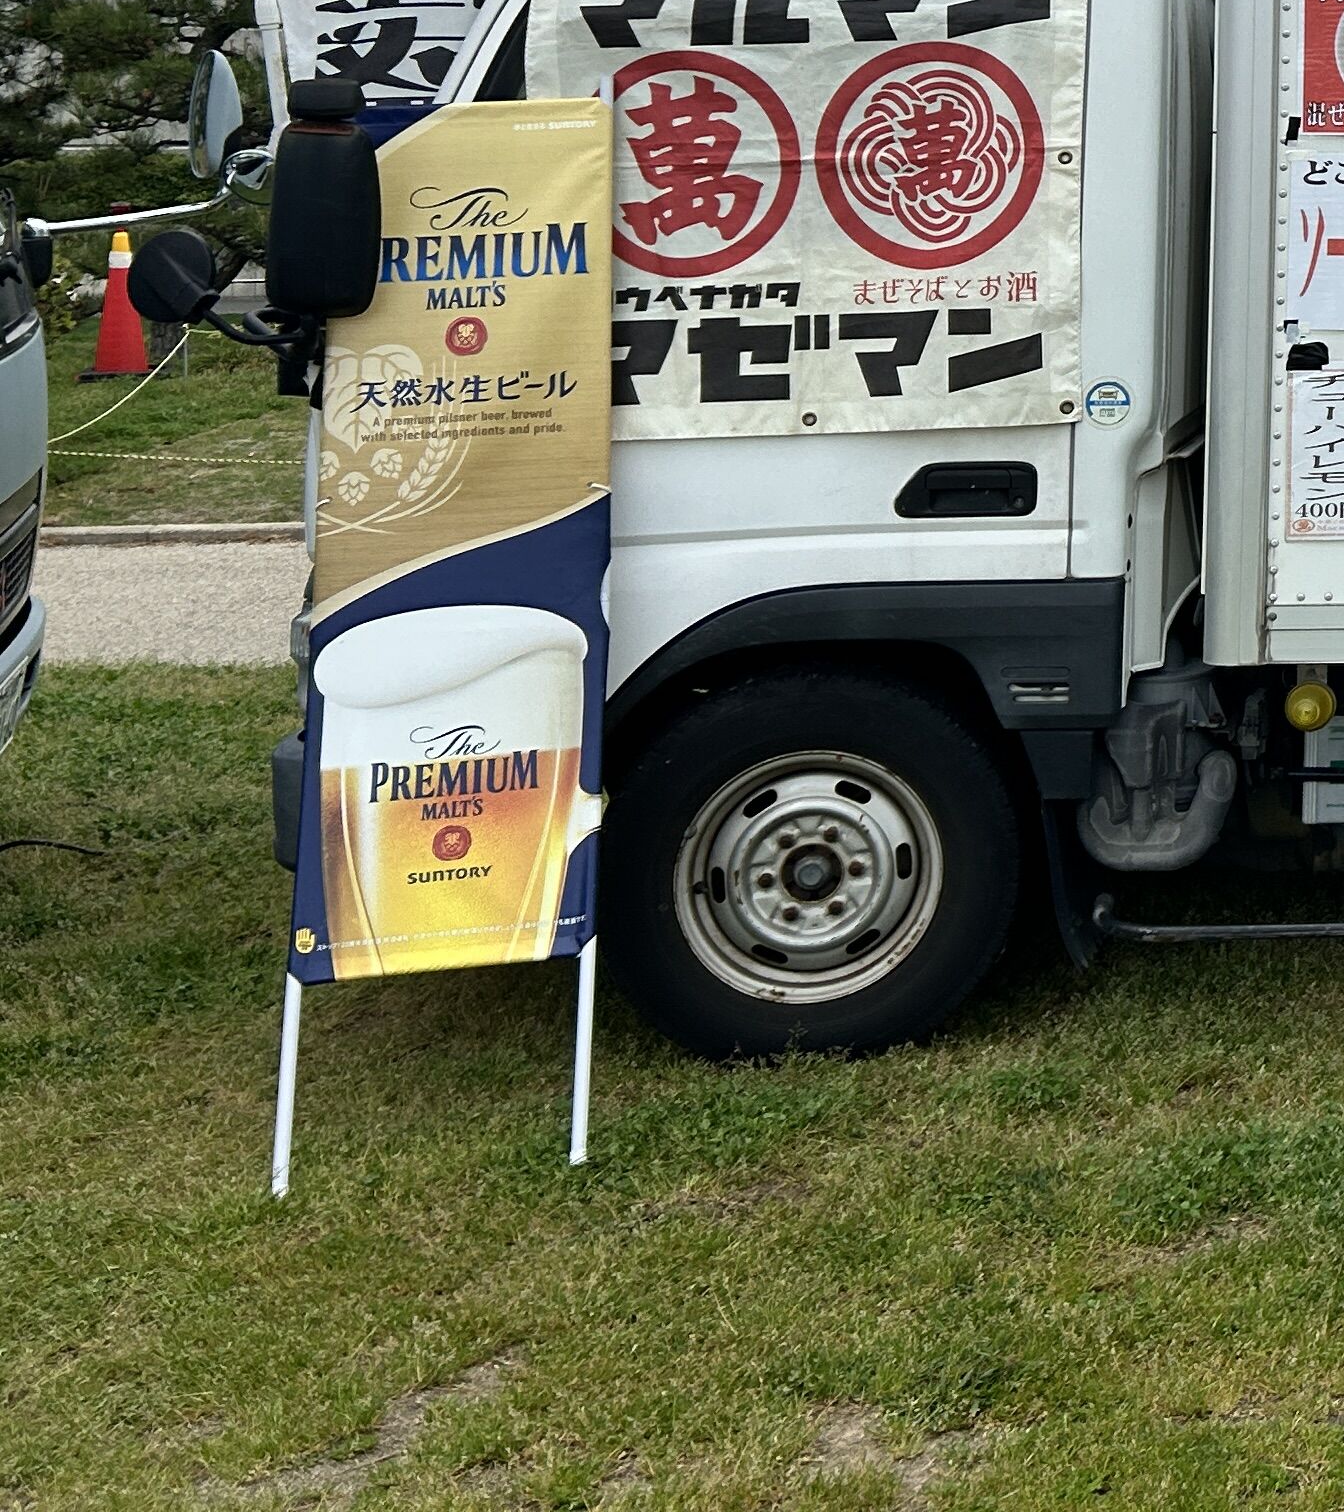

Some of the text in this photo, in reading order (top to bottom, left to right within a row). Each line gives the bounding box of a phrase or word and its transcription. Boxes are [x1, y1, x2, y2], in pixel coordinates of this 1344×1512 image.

[409, 186, 529, 231] The
[379, 222, 589, 284] REMIUM
[426, 285, 506, 311] MALT'S
[613, 282, 800, 311] ウベナガタ
[853, 272, 1038, 305] まぜそばとお酒
[350, 370, 578, 414] 天然水生ビール
[384, 413, 434, 426] premium
[512, 407, 553, 420] brewed
[361, 431, 387, 443] with
[390, 427, 438, 441] selected
[441, 423, 506, 440] ingredients
[509, 422, 531, 435] and
[410, 725, 501, 760] The
[369, 749, 541, 803] PREMIUM
[421, 797, 484, 821] MALT'S
[407, 865, 493, 884] SUNTORY
